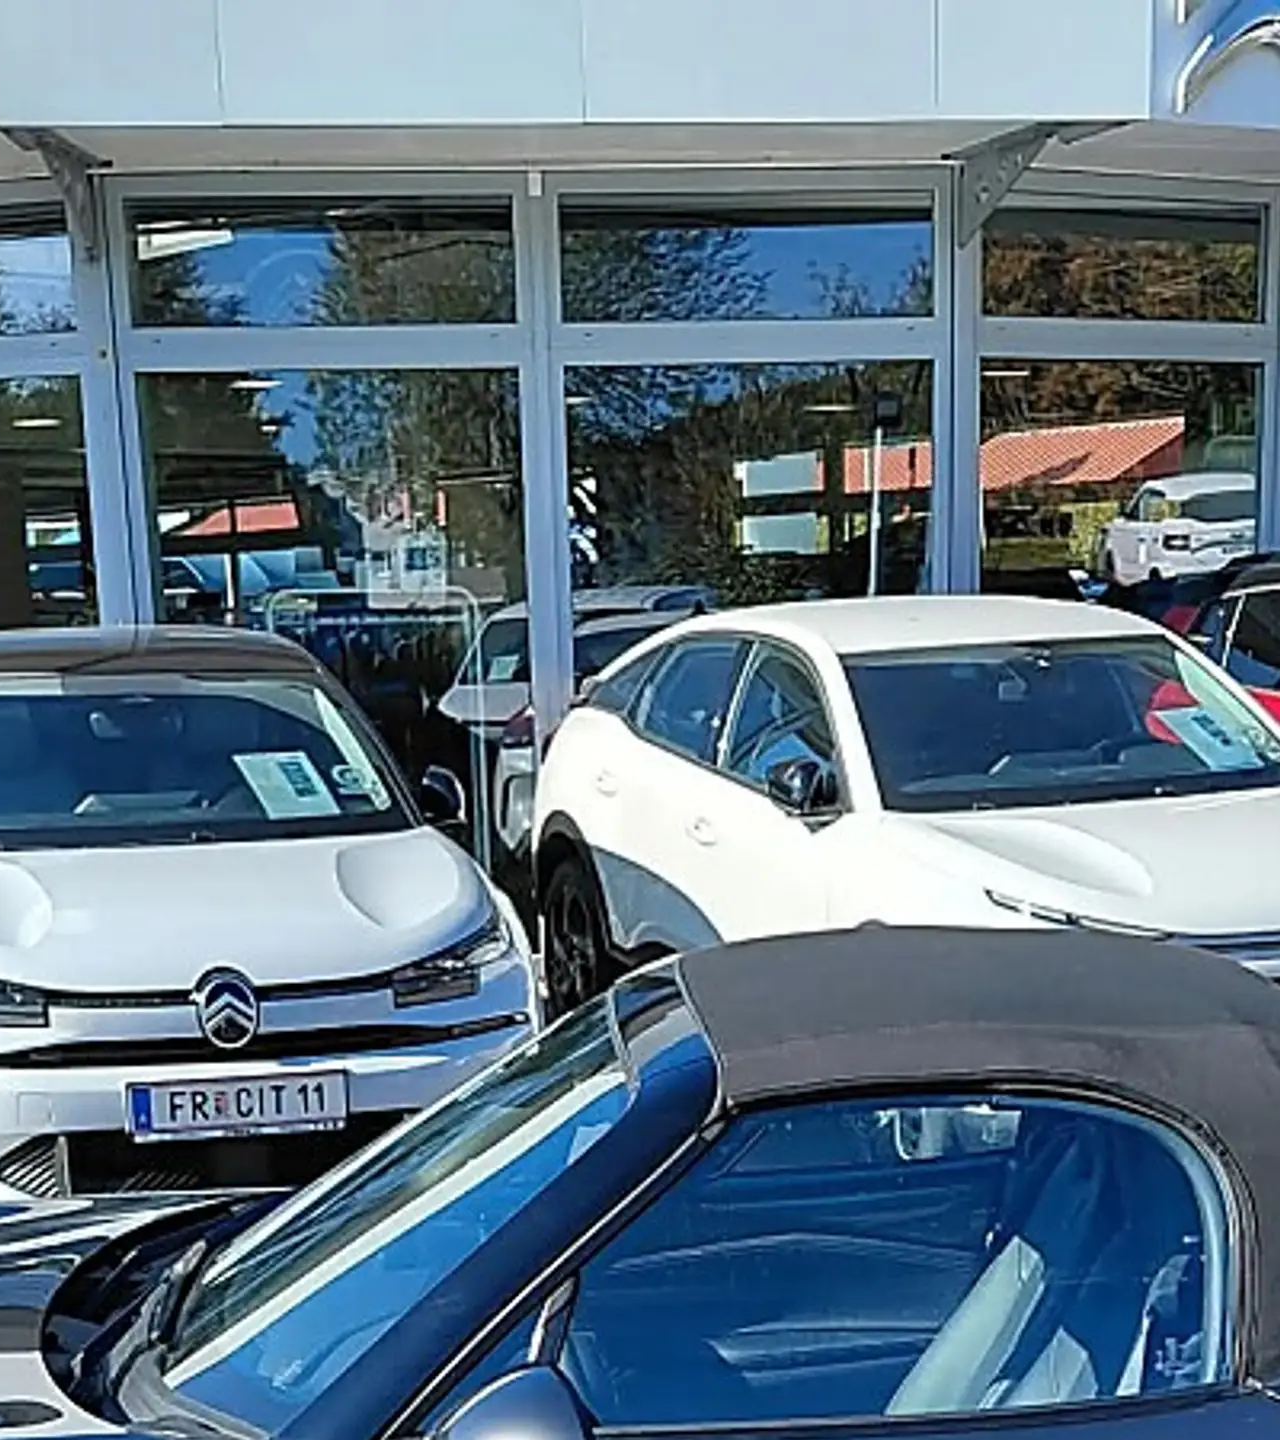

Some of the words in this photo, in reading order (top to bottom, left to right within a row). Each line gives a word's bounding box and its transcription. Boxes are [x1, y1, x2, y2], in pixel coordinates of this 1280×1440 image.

[170, 1090, 209, 1122] FR
[236, 1085, 286, 1118] CIT
[297, 1082, 325, 1114] 11
